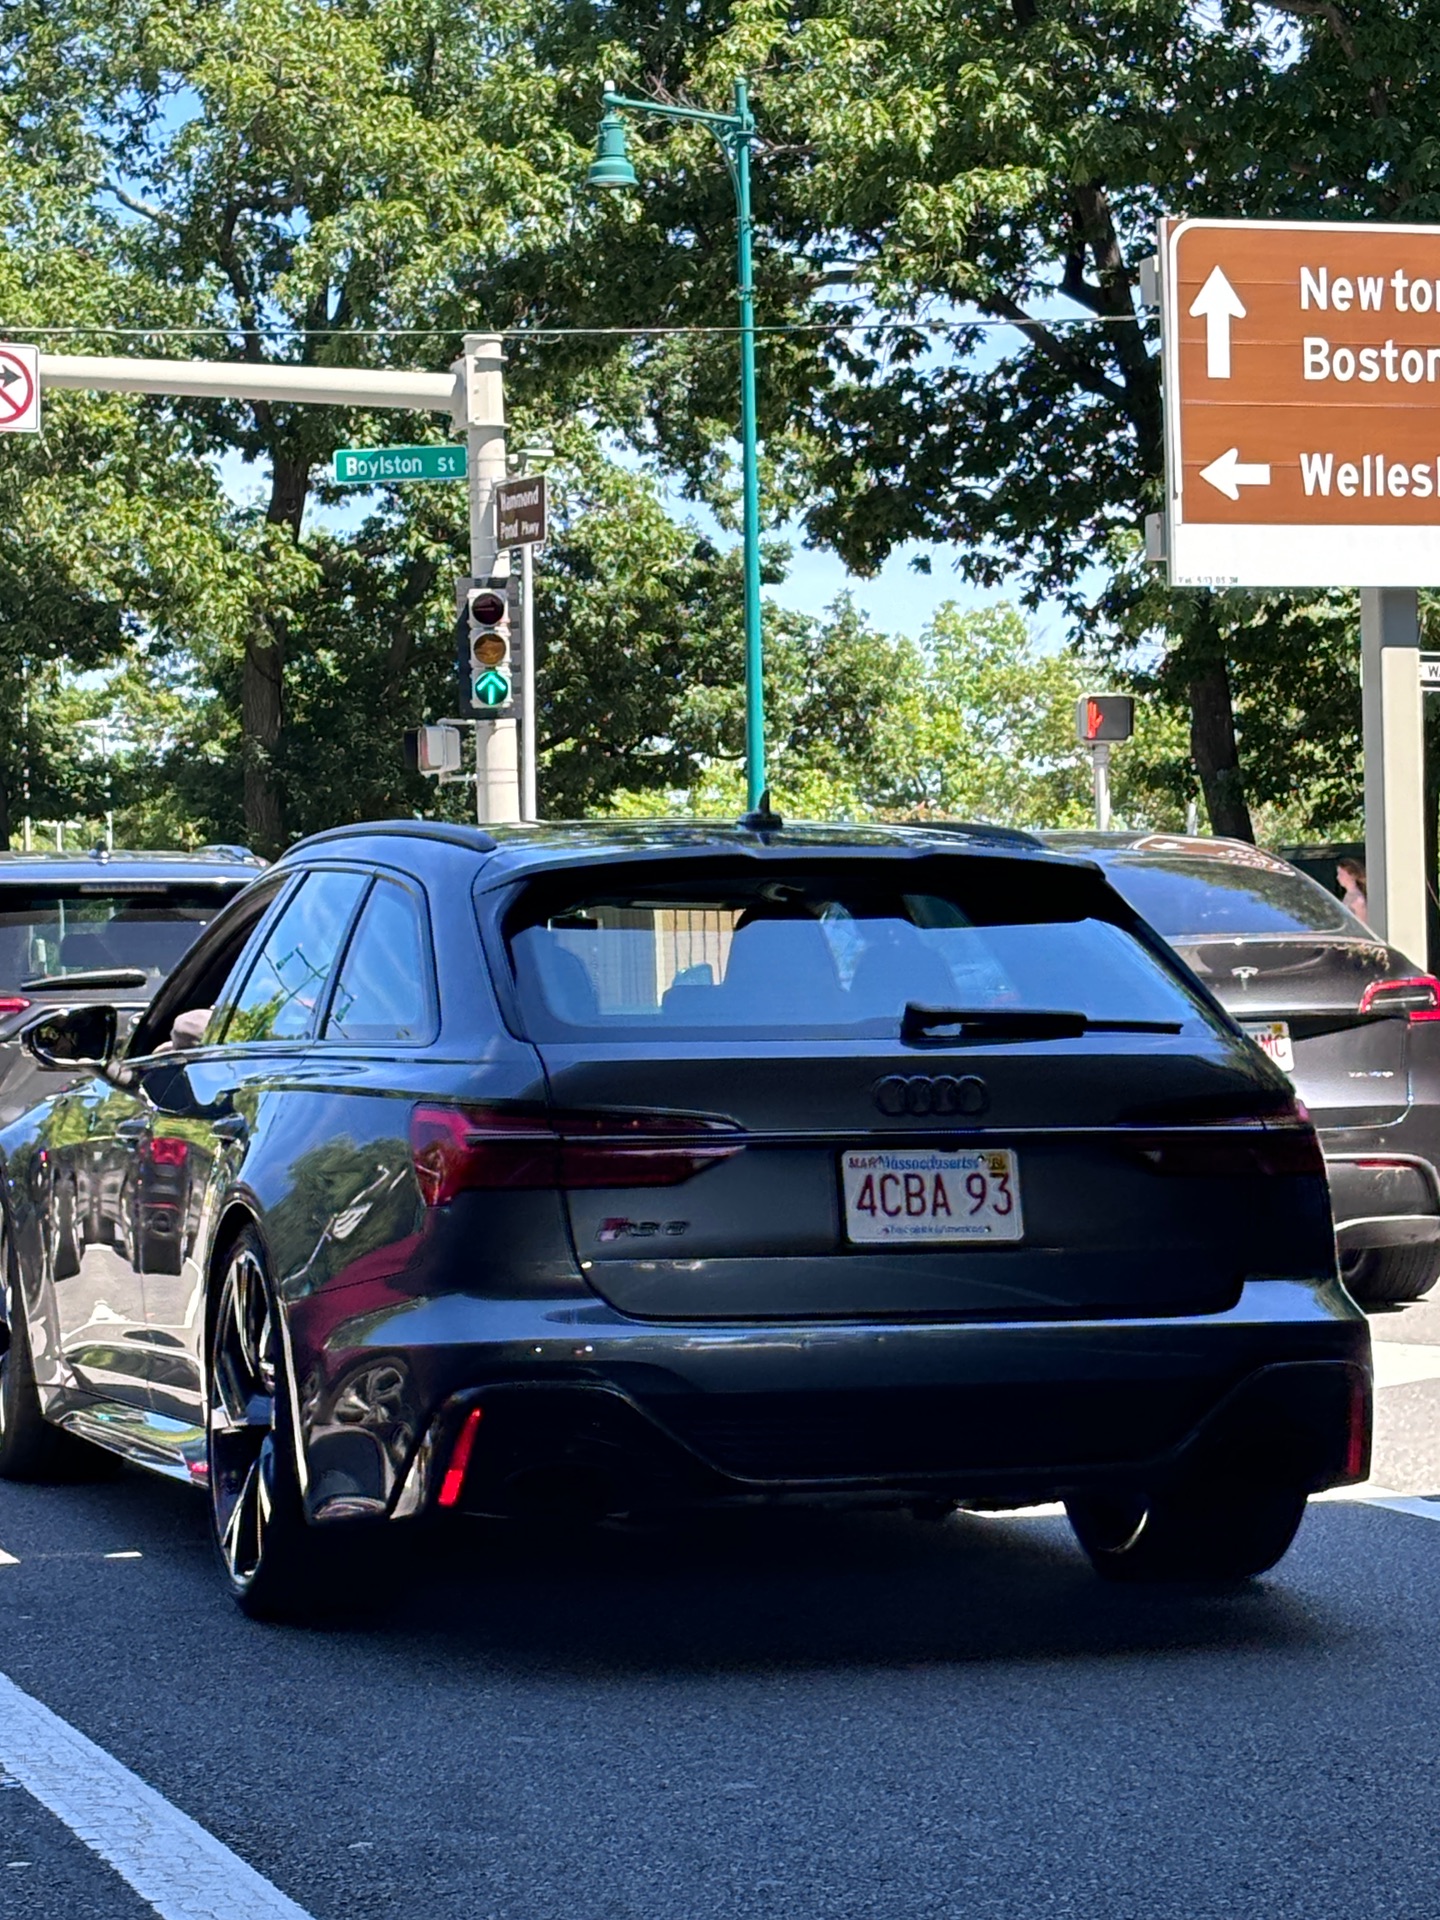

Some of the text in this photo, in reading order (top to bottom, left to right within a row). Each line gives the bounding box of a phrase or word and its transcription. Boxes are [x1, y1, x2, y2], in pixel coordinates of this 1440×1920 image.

[1300, 266, 1440, 313] Newto
[345, 456, 456, 478] Boylston St
[500, 519, 518, 540] Pond
[857, 1172, 1013, 1217] 4CBA 93
